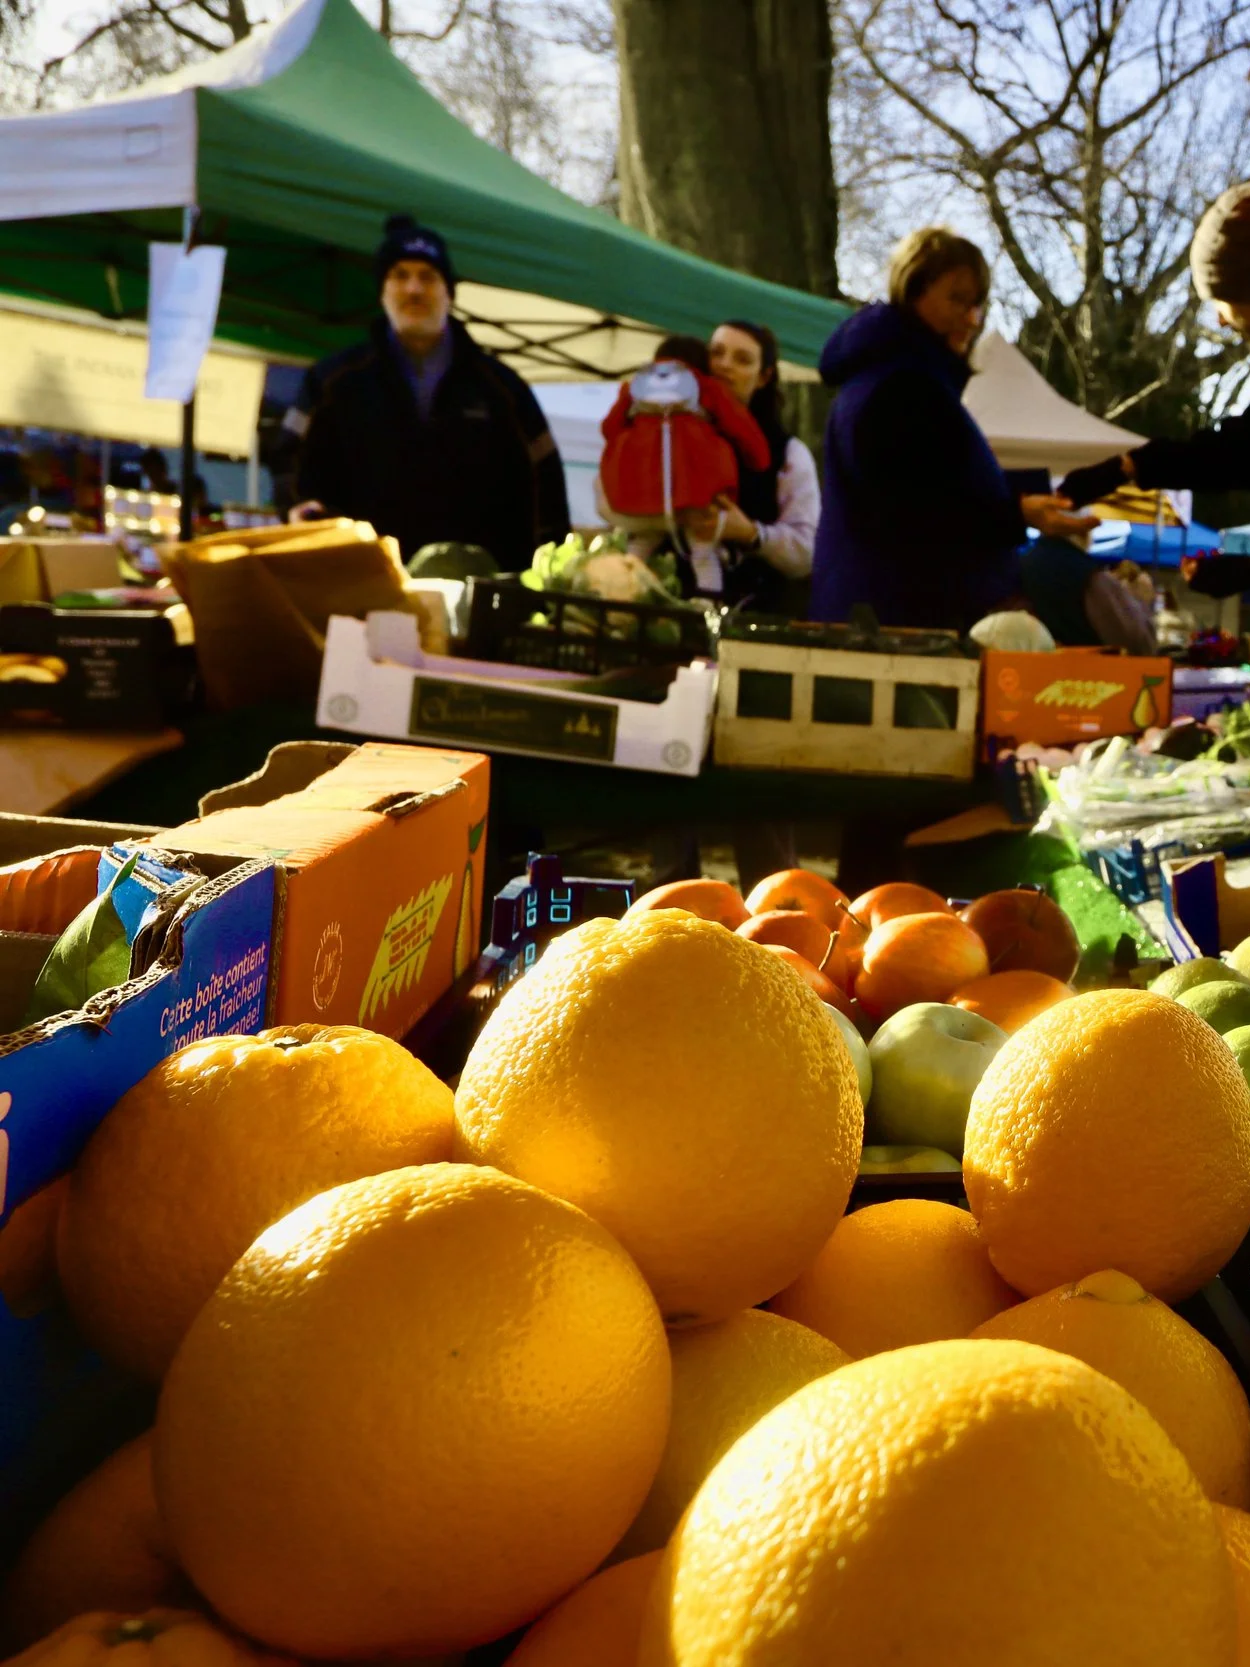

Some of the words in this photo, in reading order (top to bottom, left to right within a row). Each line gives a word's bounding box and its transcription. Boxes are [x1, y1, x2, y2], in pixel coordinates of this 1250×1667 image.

[160, 997, 193, 1037] Cette
[195, 973, 224, 1013] boîte
[224, 941, 266, 990] contient
[207, 1004, 217, 1034] la
[219, 974, 263, 1025] fraîcheur
